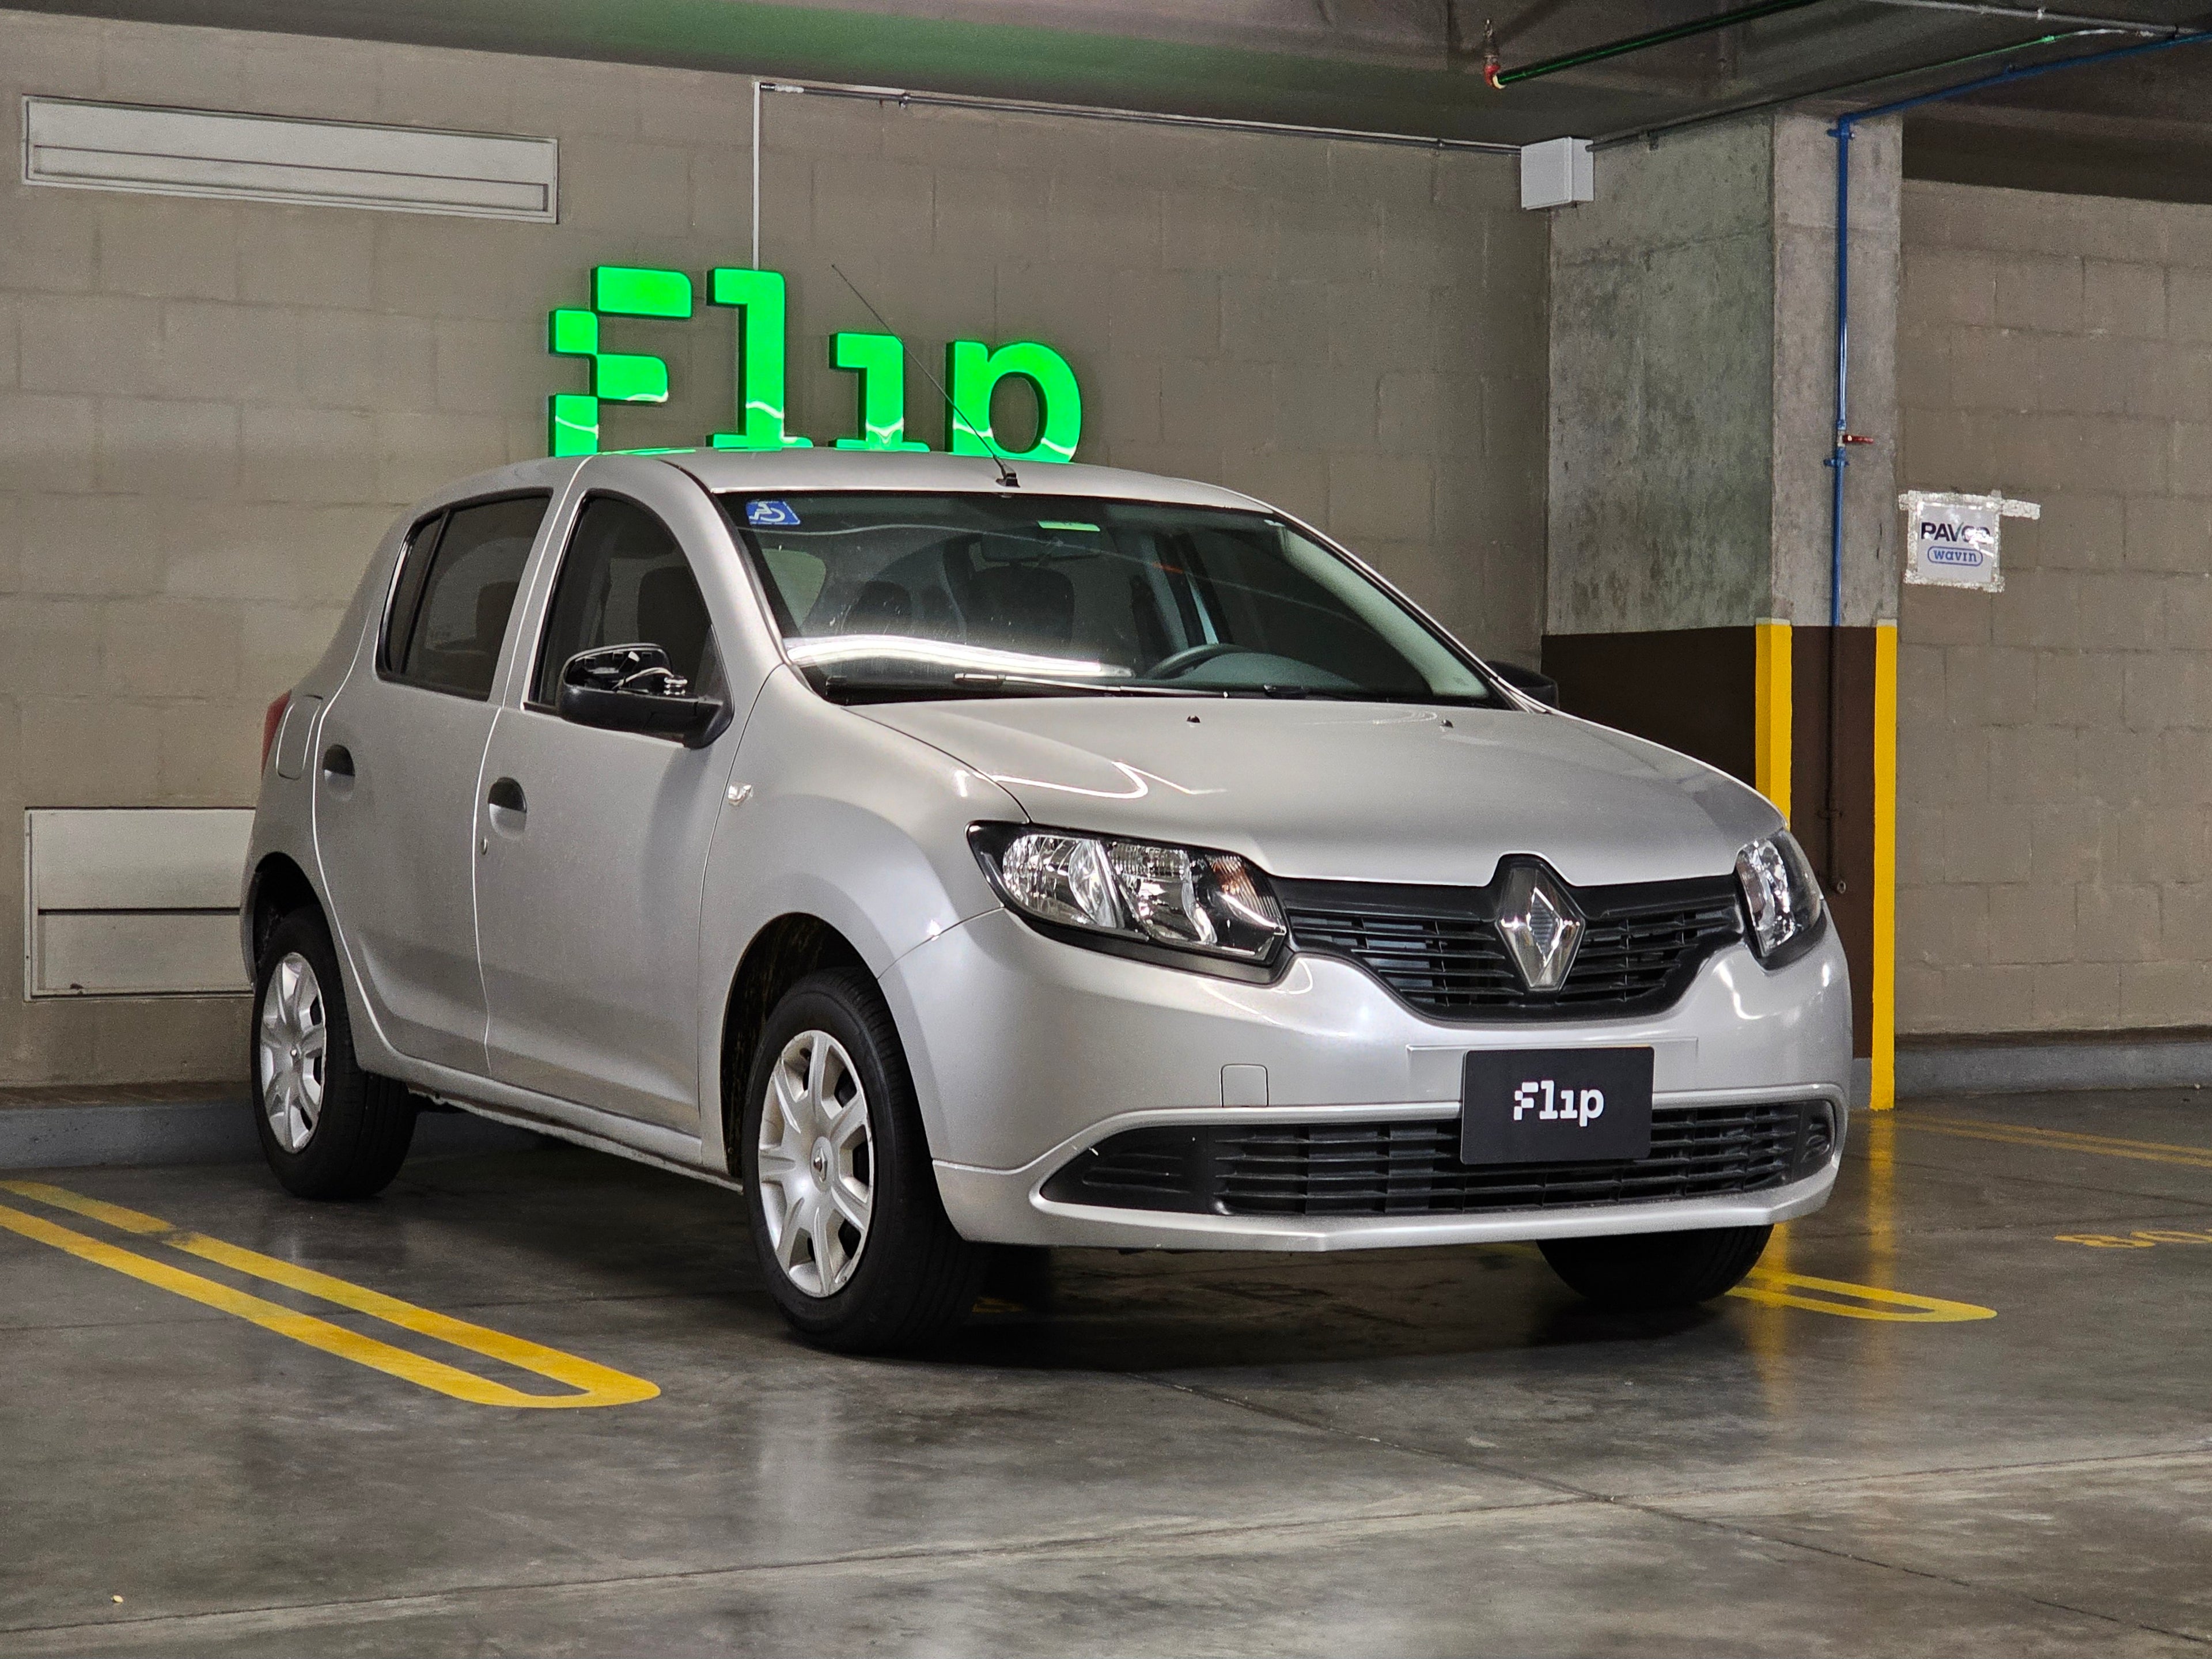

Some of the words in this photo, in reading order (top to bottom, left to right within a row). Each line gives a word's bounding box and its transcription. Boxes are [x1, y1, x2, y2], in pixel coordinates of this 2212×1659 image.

[551, 266, 1081, 462] Flip
[1934, 550, 1977, 562] wavin
[1513, 1080, 1604, 1127] Flip
